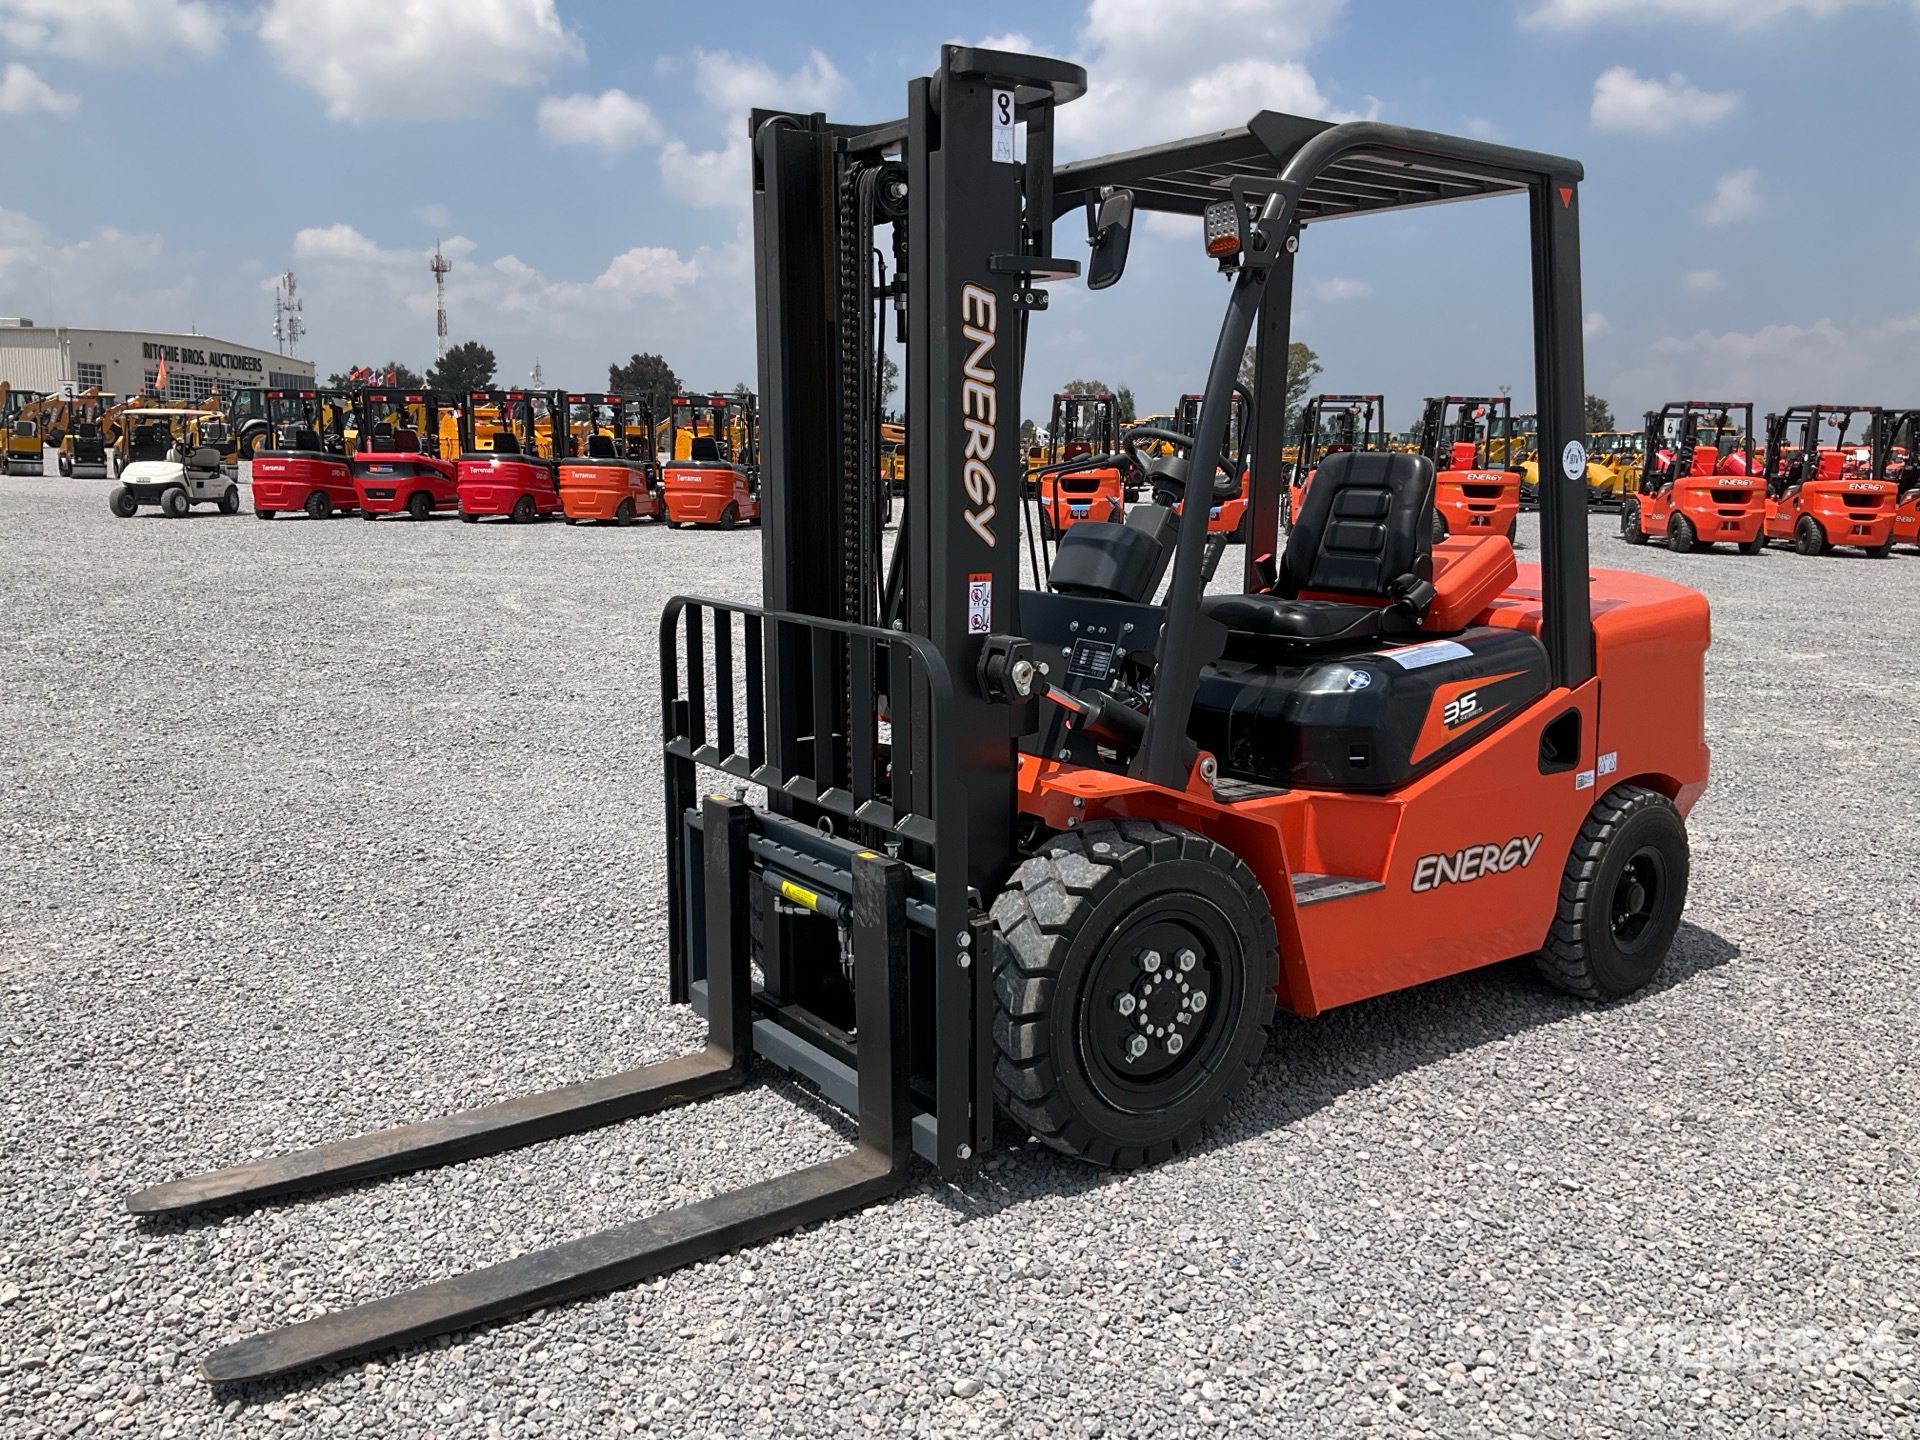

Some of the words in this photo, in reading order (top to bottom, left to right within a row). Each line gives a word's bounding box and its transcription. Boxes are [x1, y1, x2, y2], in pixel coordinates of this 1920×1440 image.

[143, 342, 180, 363] RITCHIE
[181, 348, 207, 366] BROS.
[208, 351, 263, 372] AUCTIONEERS
[64, 386, 73, 398] 3
[962, 284, 997, 548] ENERGY
[1667, 422, 1673, 434] 6
[262, 464, 286, 472] Terramax
[469, 466, 495, 474] Terramax
[571, 471, 597, 479] Terramax
[676, 474, 702, 482] Terramax
[1467, 473, 1503, 481] ENERGY
[1718, 478, 1754, 487] ENERGY
[1848, 483, 1884, 491] ENERGY
[1895, 515, 1916, 523] ENERGY
[1443, 691, 1477, 724] 35
[1411, 832, 1543, 893] ENERGY
